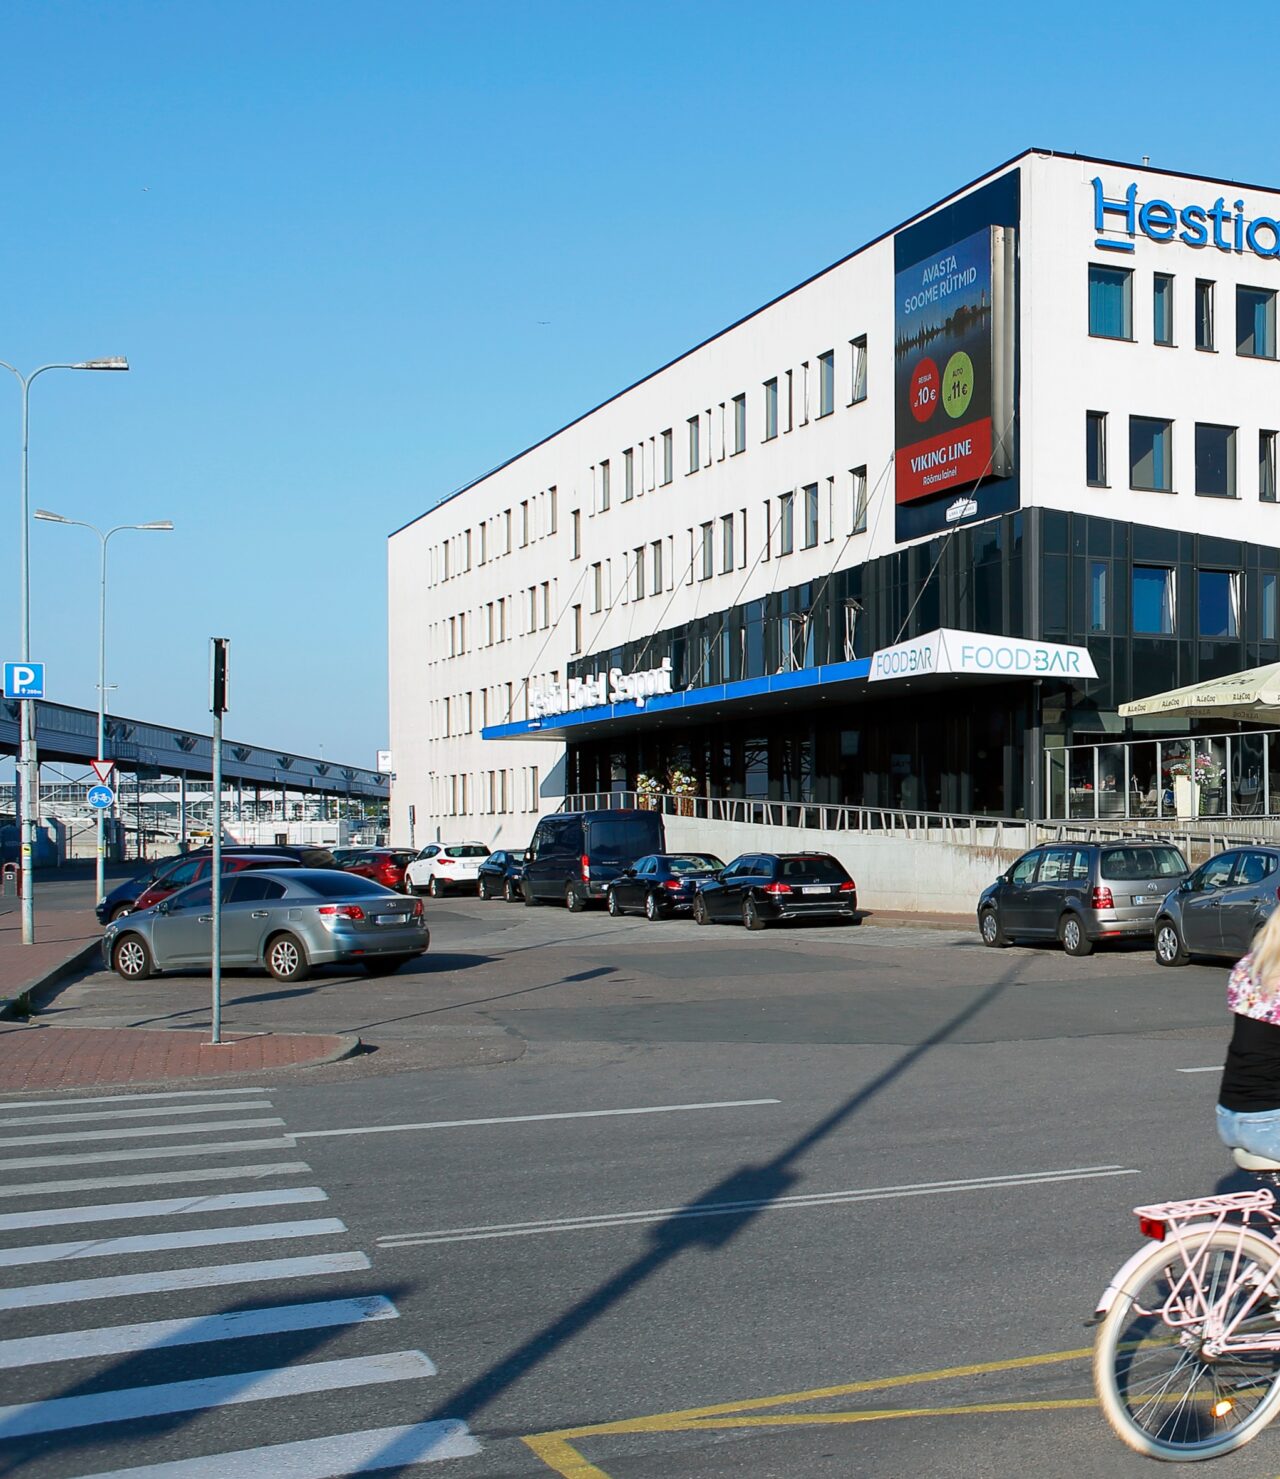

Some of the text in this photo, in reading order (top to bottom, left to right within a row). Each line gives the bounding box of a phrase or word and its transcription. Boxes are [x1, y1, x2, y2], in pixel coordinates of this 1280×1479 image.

[922, 255, 958, 286] AVASTA
[904, 266, 977, 315] SOOME RÜTMID
[910, 438, 972, 473] VIKING LINE
[13, 666, 35, 694] P
[609, 656, 673, 708] Seaport
